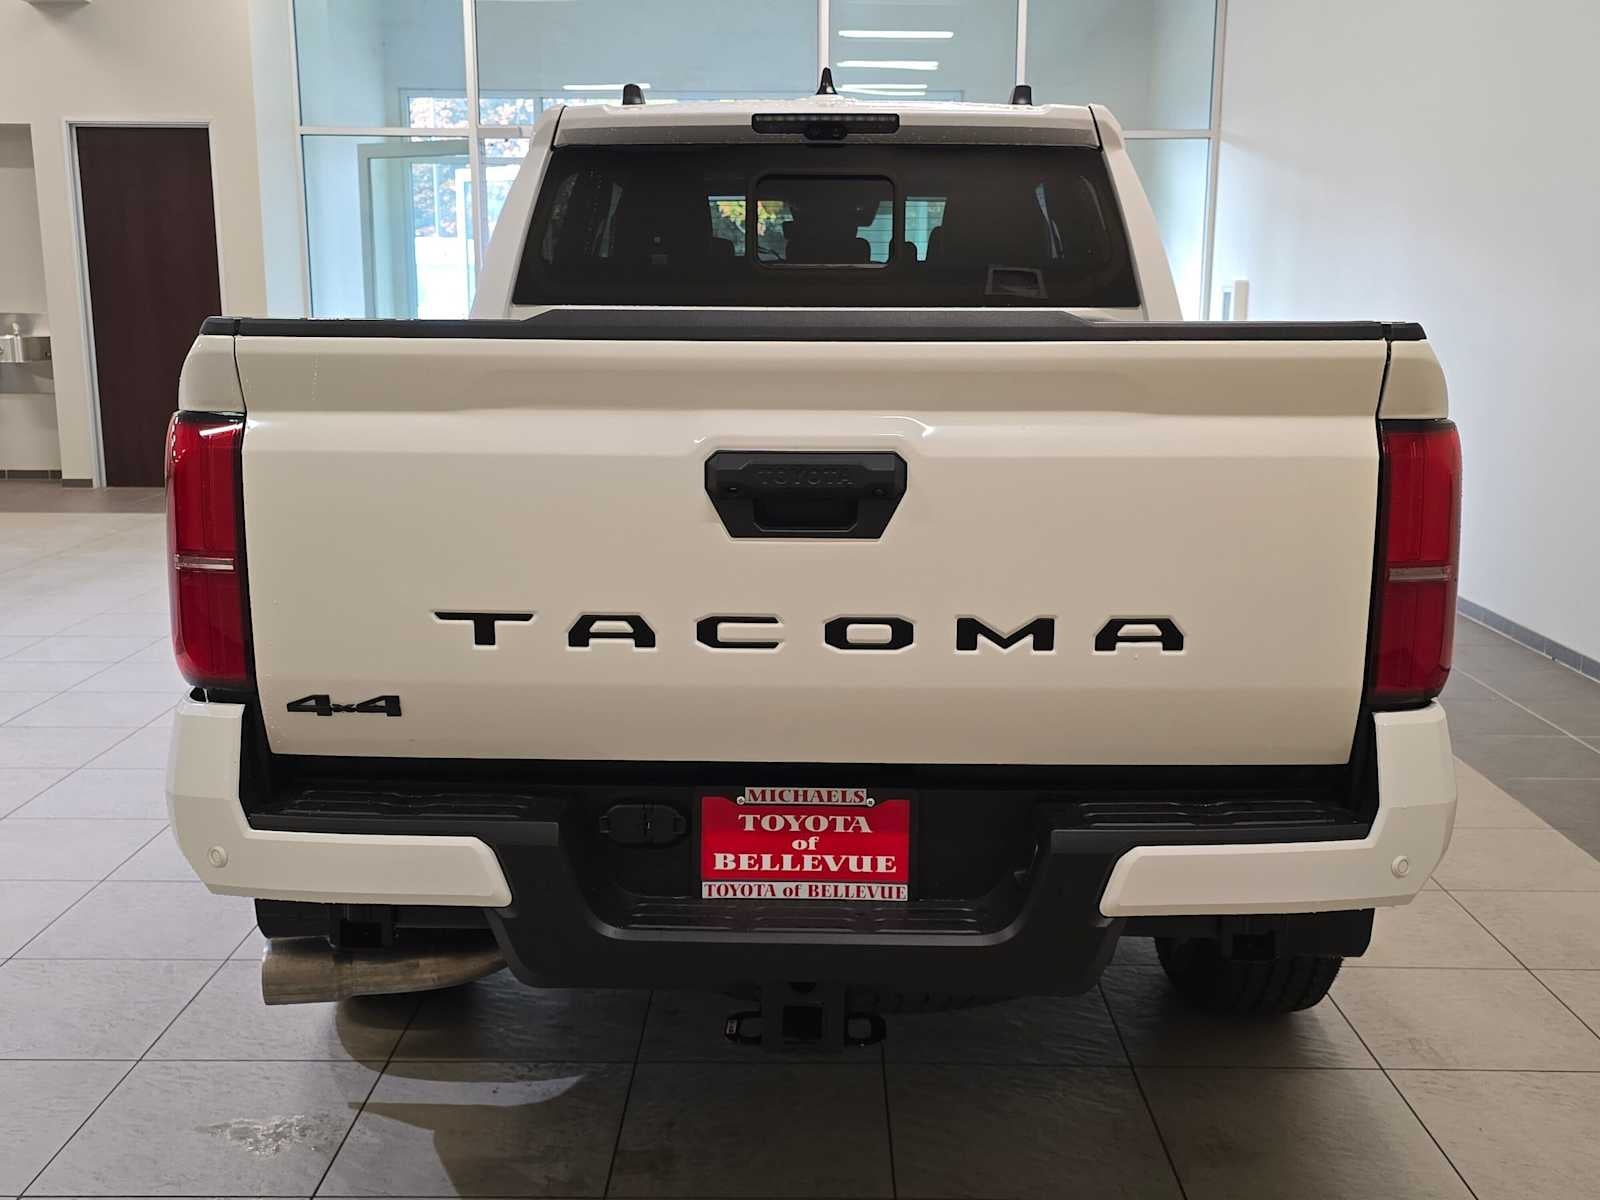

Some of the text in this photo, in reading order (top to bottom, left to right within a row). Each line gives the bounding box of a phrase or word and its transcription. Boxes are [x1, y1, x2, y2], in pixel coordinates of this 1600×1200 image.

[757, 470, 854, 486] TOYOTA
[434, 612, 1184, 651] TACOMA
[286, 694, 402, 717] 4x4
[748, 788, 866, 804] MICHAELS
[738, 814, 873, 833] TOYOTA
[791, 836, 820, 851] of
[713, 852, 897, 873] BELLEVUE
[704, 883, 907, 900] TOYOTA of BELLEVUE
